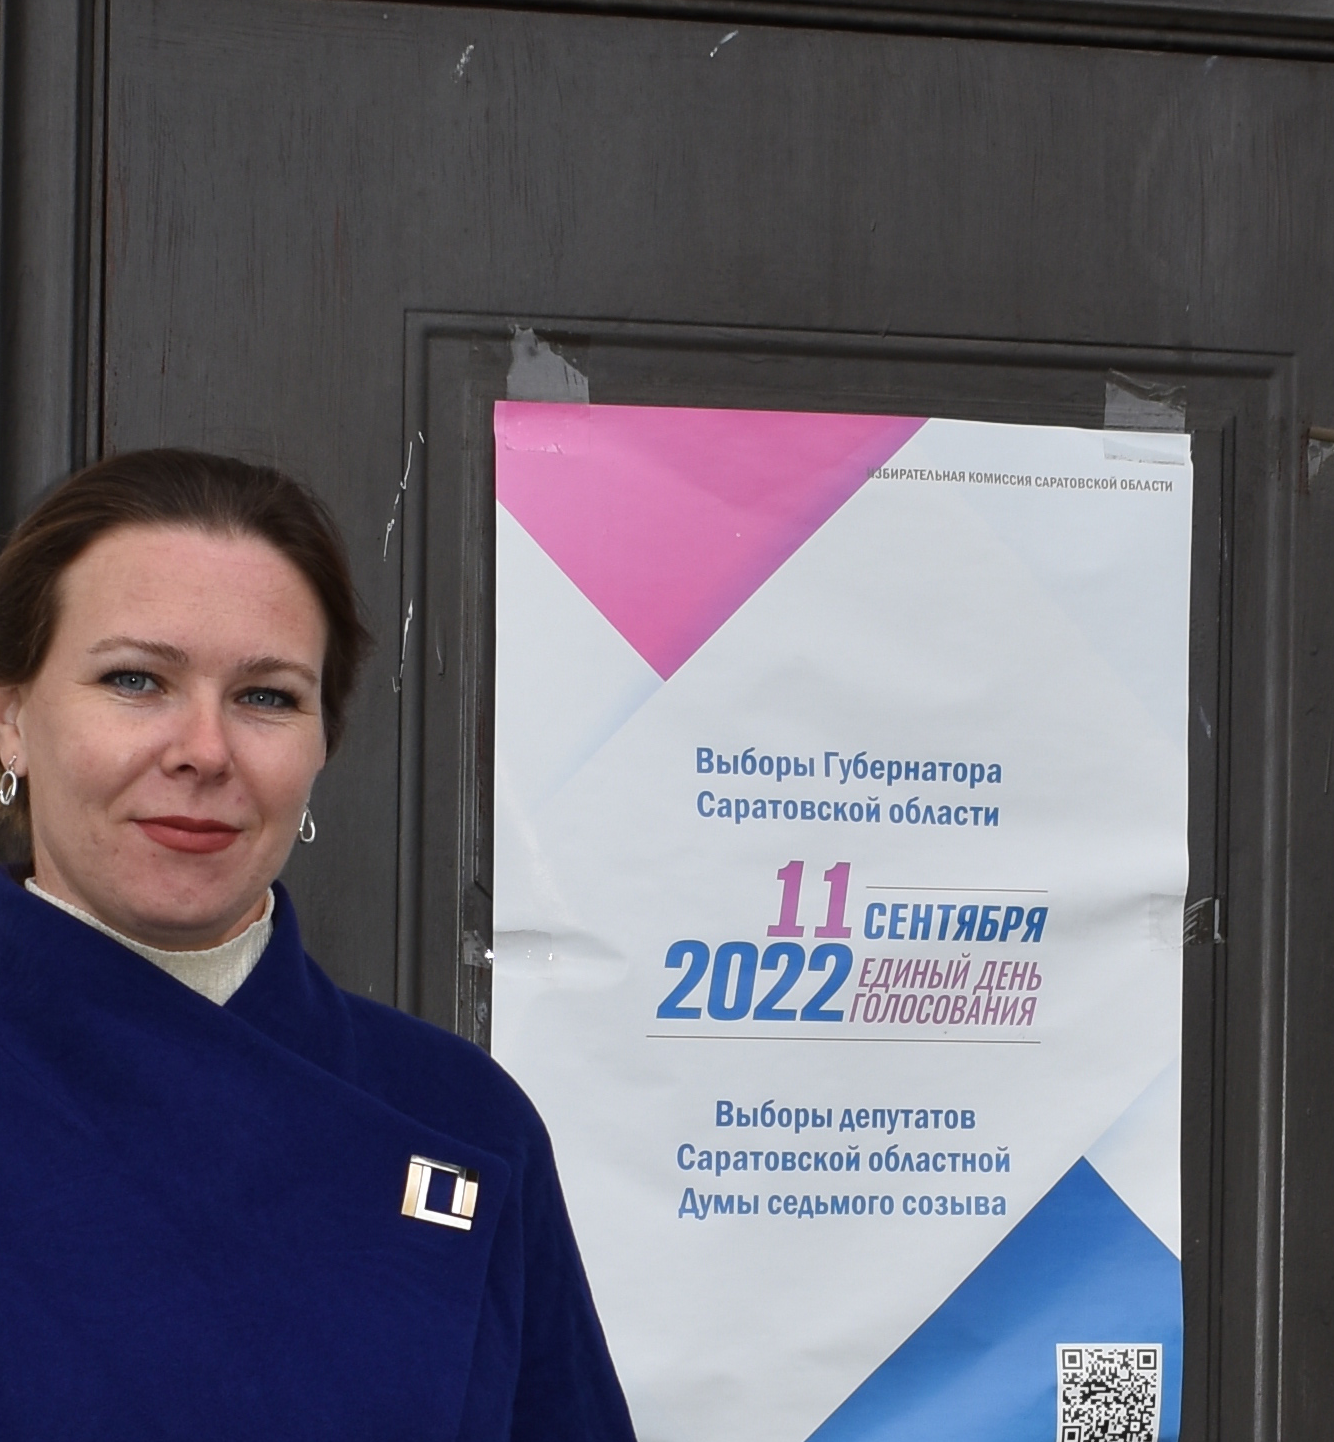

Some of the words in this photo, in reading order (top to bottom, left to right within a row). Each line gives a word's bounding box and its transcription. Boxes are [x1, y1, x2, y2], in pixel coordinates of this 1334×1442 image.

[867, 468, 966, 483] ИЗБИРАТЕЛЬНАЯ
[968, 471, 1032, 486] КОМИССИЯ
[1035, 474, 1117, 490] САРАТОВСКОЙ
[1120, 479, 1173, 492] ОБЛАСТИ
[696, 747, 815, 780] Выборы
[824, 750, 1002, 789] Губернатора
[696, 791, 881, 825] Саратовской
[888, 797, 1000, 827] области
[766, 860, 852, 939] 11
[863, 902, 1049, 943] СЕНТЯБРЯ
[656, 940, 854, 1023] 2022
[858, 952, 970, 993] ЕДИНЫЙ
[973, 960, 1042, 992] ДЕНЬ
[849, 992, 1037, 1026] ГОЛОСОВАНИЯ
[715, 1100, 833, 1132] Выборы
[839, 1108, 976, 1135] депутатов
[676, 1143, 861, 1176] Саратовской
[868, 1143, 1010, 1173] областной
[678, 1187, 759, 1221] Думы
[767, 1194, 895, 1219] седьмого
[902, 1195, 1007, 1216] созыва
